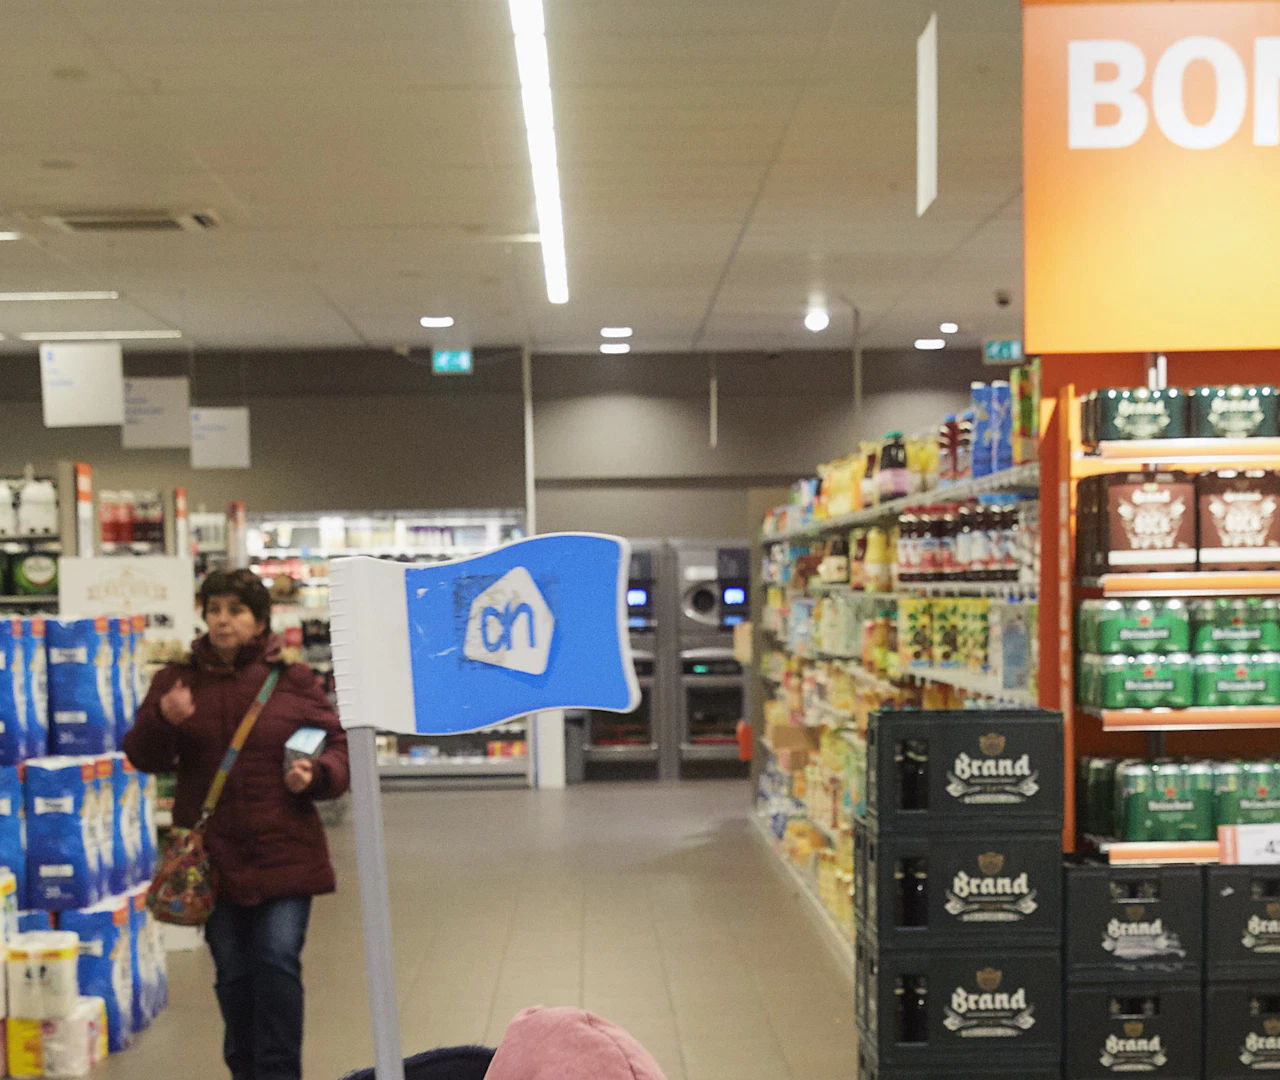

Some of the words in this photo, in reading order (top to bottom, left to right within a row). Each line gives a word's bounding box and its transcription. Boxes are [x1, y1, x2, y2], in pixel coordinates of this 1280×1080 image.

[954, 752, 1032, 780] Brand
[952, 870, 1030, 898] Brand
[1107, 916, 1163, 937] Brand
[951, 986, 1027, 1012] Brand
[1106, 1033, 1162, 1054] Brand
